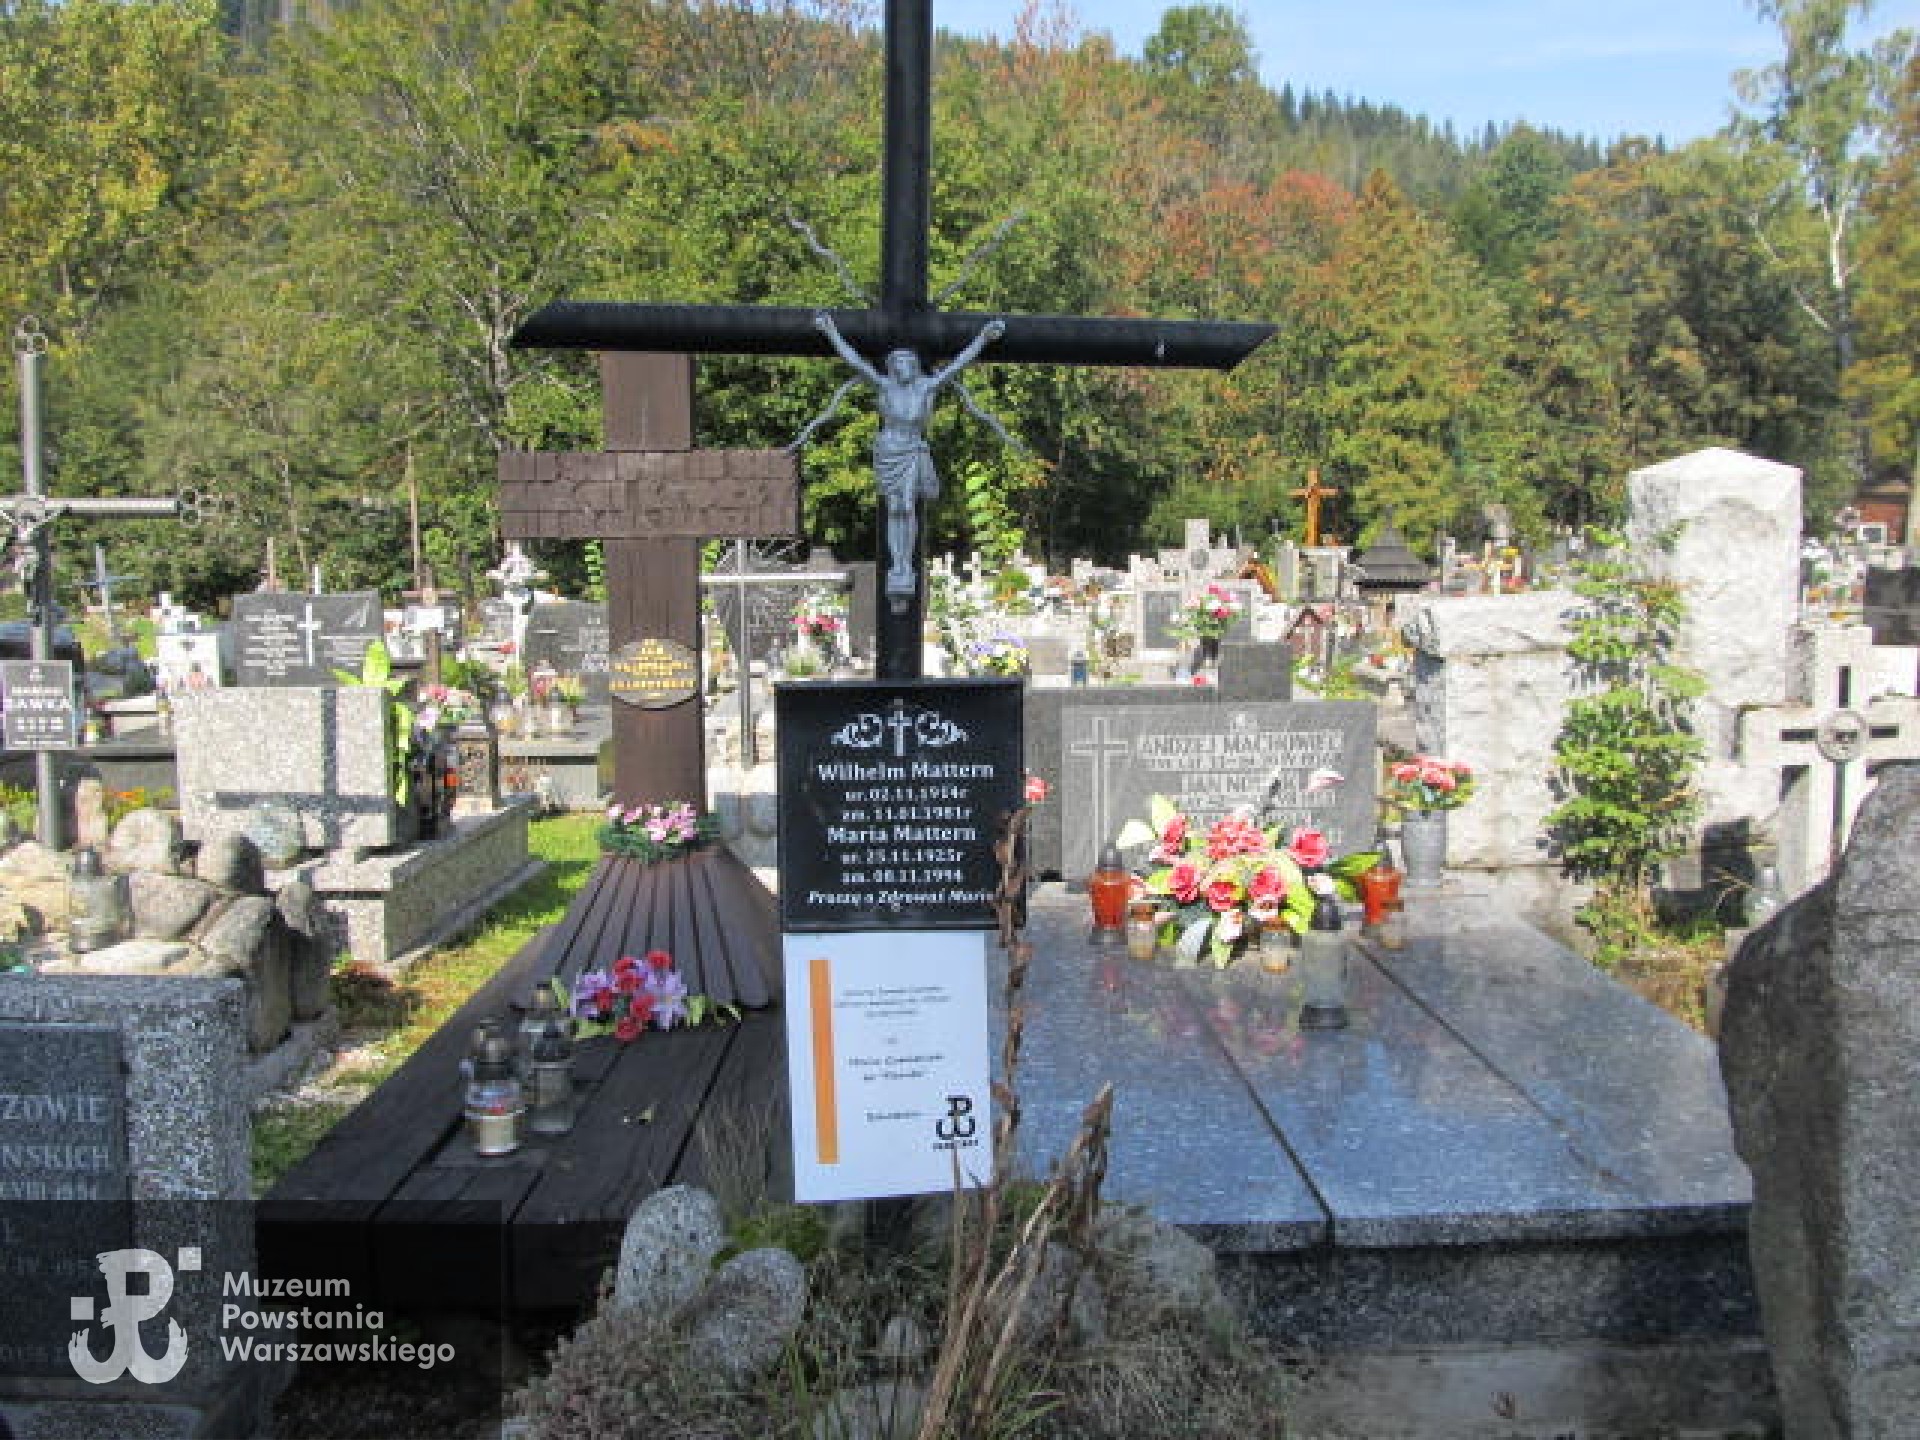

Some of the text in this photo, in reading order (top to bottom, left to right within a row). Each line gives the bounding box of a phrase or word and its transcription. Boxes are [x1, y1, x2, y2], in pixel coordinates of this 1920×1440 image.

[817, 761, 995, 780] Wilhelm Mattern
[827, 824, 976, 844] Maria Mattern
